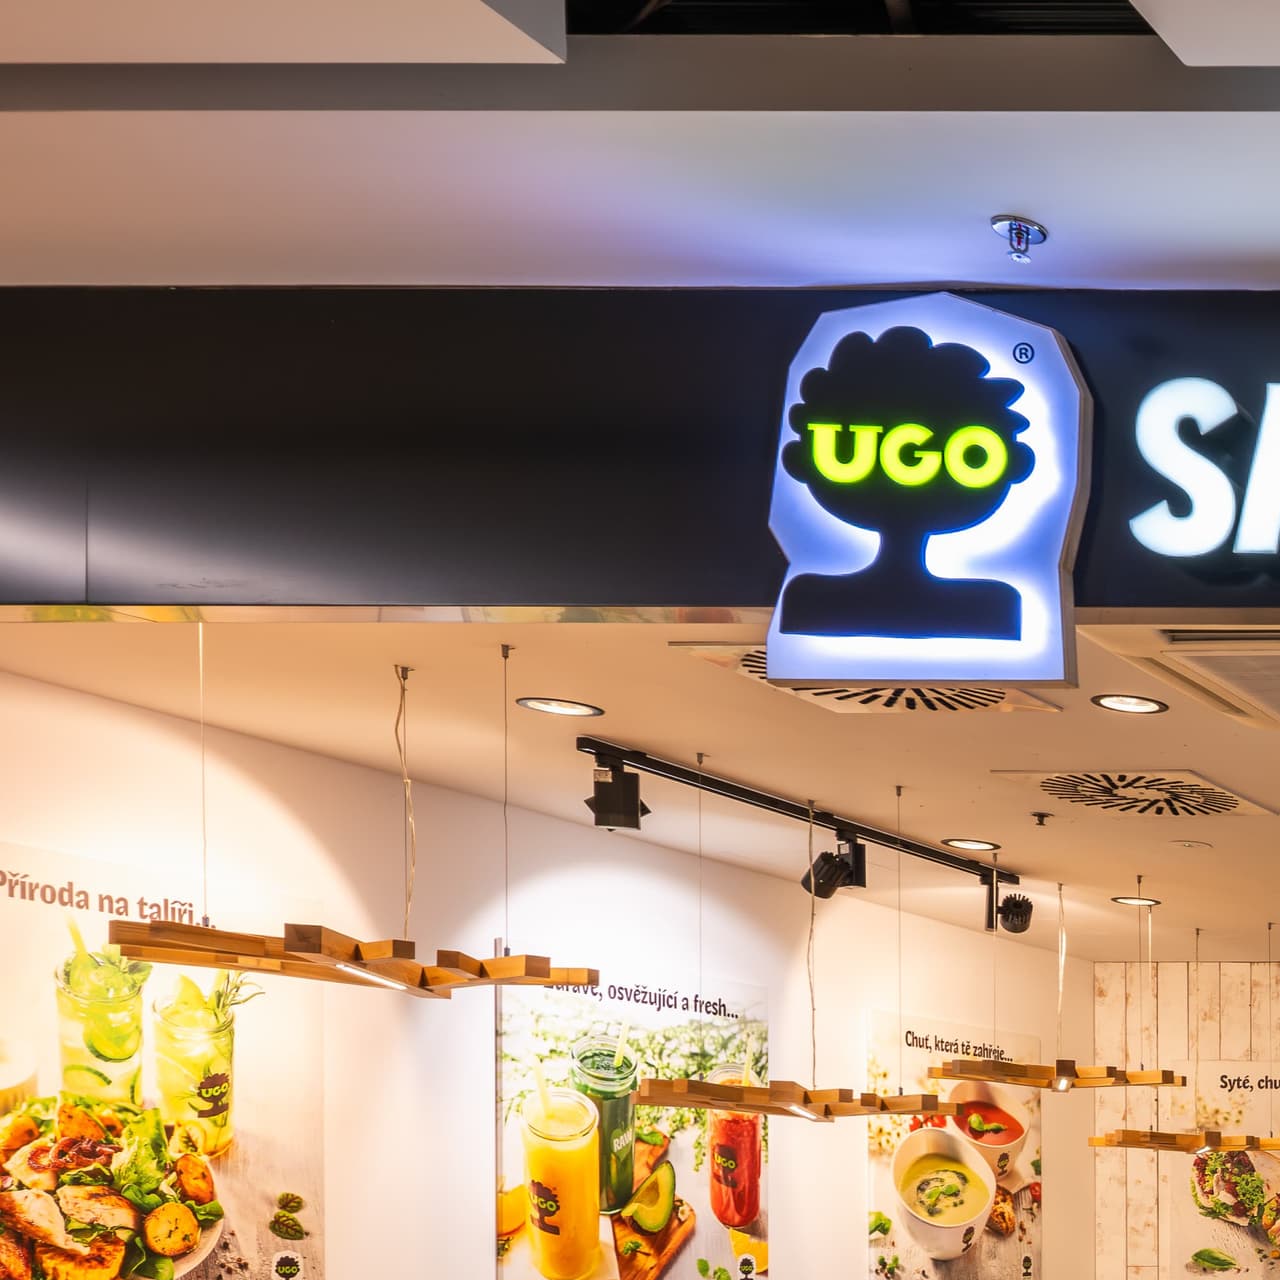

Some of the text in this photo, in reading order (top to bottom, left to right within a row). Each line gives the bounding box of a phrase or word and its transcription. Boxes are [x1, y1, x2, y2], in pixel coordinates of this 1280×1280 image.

[807, 423, 1007, 488] UGO
[98, 893, 129, 916] na
[608, 984, 678, 1012] osvěžující
[682, 998, 689, 1011] a
[905, 1030, 932, 1053] Chuť,
[934, 1035, 959, 1054] která
[961, 1040, 971, 1056] tě
[201, 1082, 229, 1098] UGO
[1220, 1074, 1254, 1092] Syté,
[613, 1129, 633, 1151] RAW
[714, 1154, 736, 1169] UGO
[277, 1266, 299, 1274] UGO
